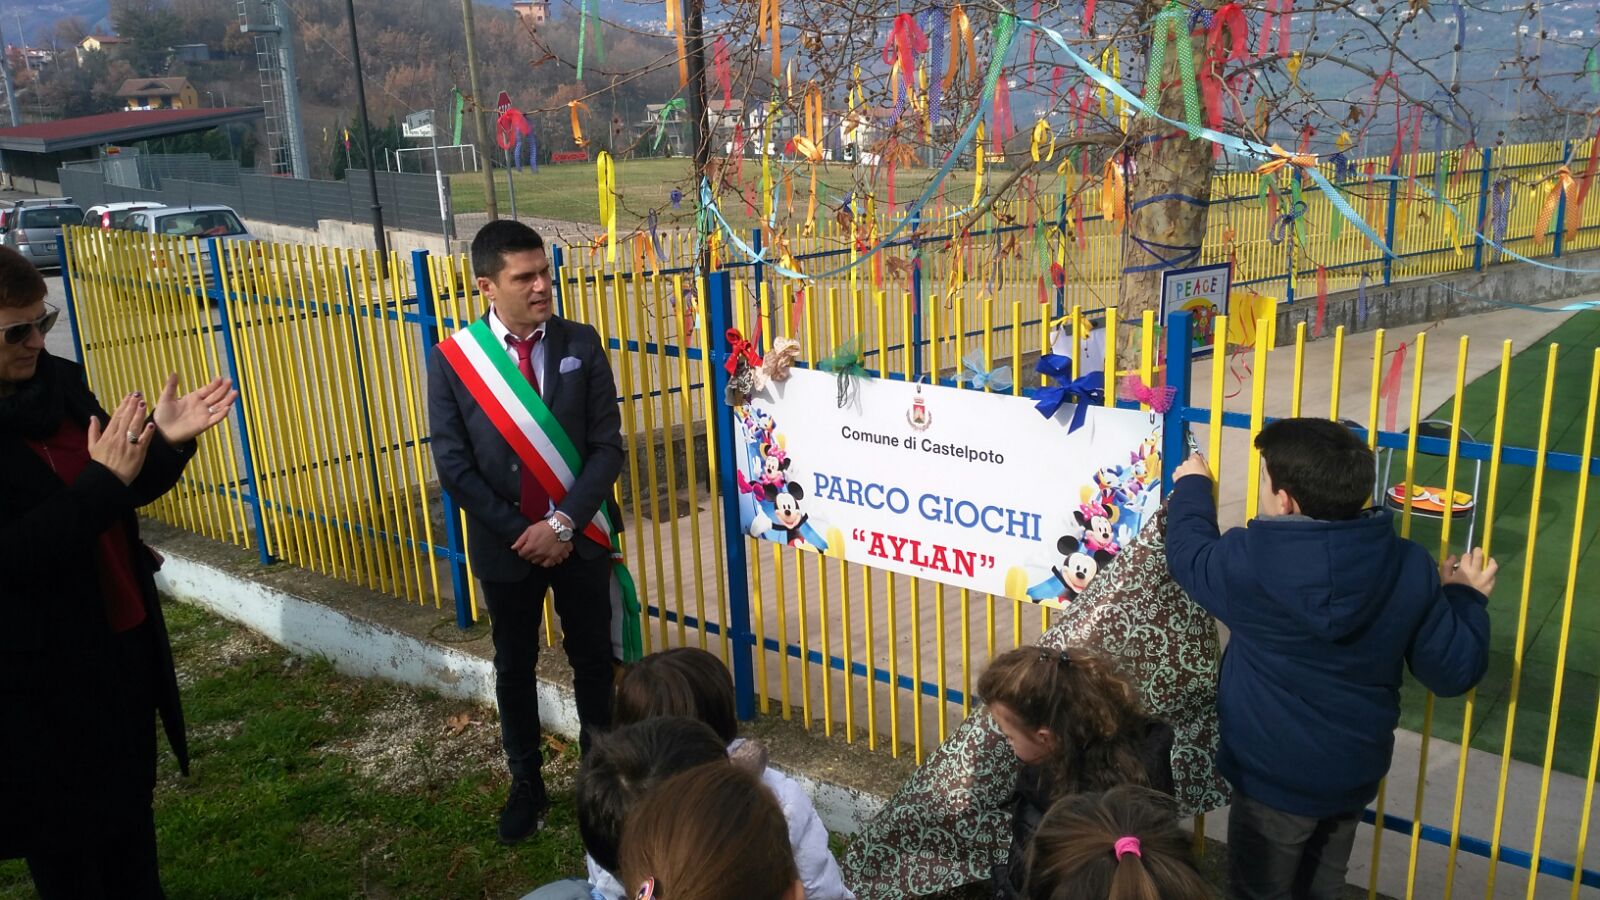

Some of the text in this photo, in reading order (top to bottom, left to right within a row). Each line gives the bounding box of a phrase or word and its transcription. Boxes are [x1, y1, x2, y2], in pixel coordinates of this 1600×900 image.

[1176, 276, 1218, 299] PEACE
[841, 425, 1005, 464] Comune di Castelpoto
[813, 472, 1042, 541] PARCO GIOCHI
[852, 528, 995, 577] “AYLAN”
